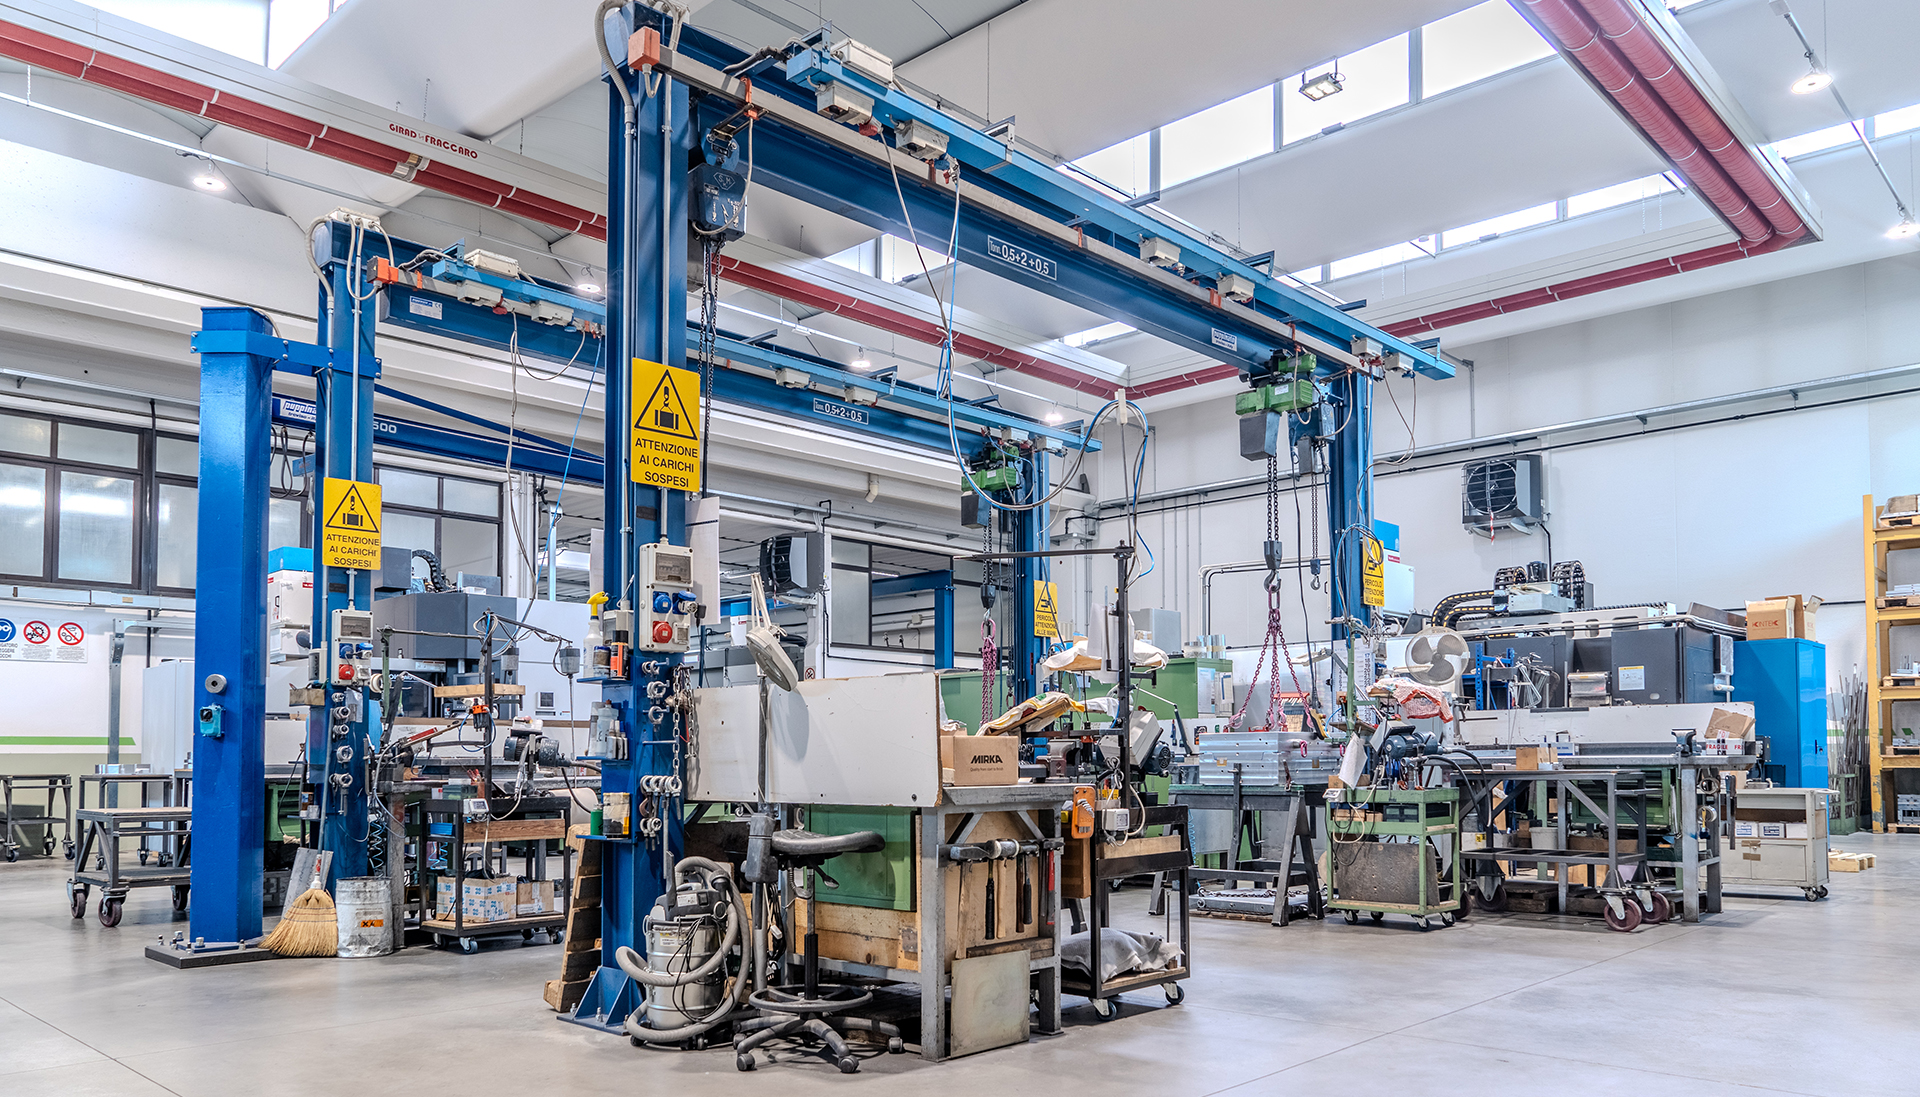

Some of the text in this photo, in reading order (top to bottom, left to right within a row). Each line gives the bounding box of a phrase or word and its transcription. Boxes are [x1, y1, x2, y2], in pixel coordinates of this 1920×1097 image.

[389, 123, 478, 159] GIRAD FRACCARO
[635, 437, 698, 458] ATTENZIONE
[639, 454, 694, 473] AI CARICHI
[644, 471, 689, 488] SOSPESI
[325, 533, 380, 547] ATTENZIONE
[329, 545, 377, 557] AI CARICHI
[333, 556, 372, 568] SOSPESI
[1752, 620, 1779, 628] KINTEK
[970, 754, 1003, 764] MIRKA
